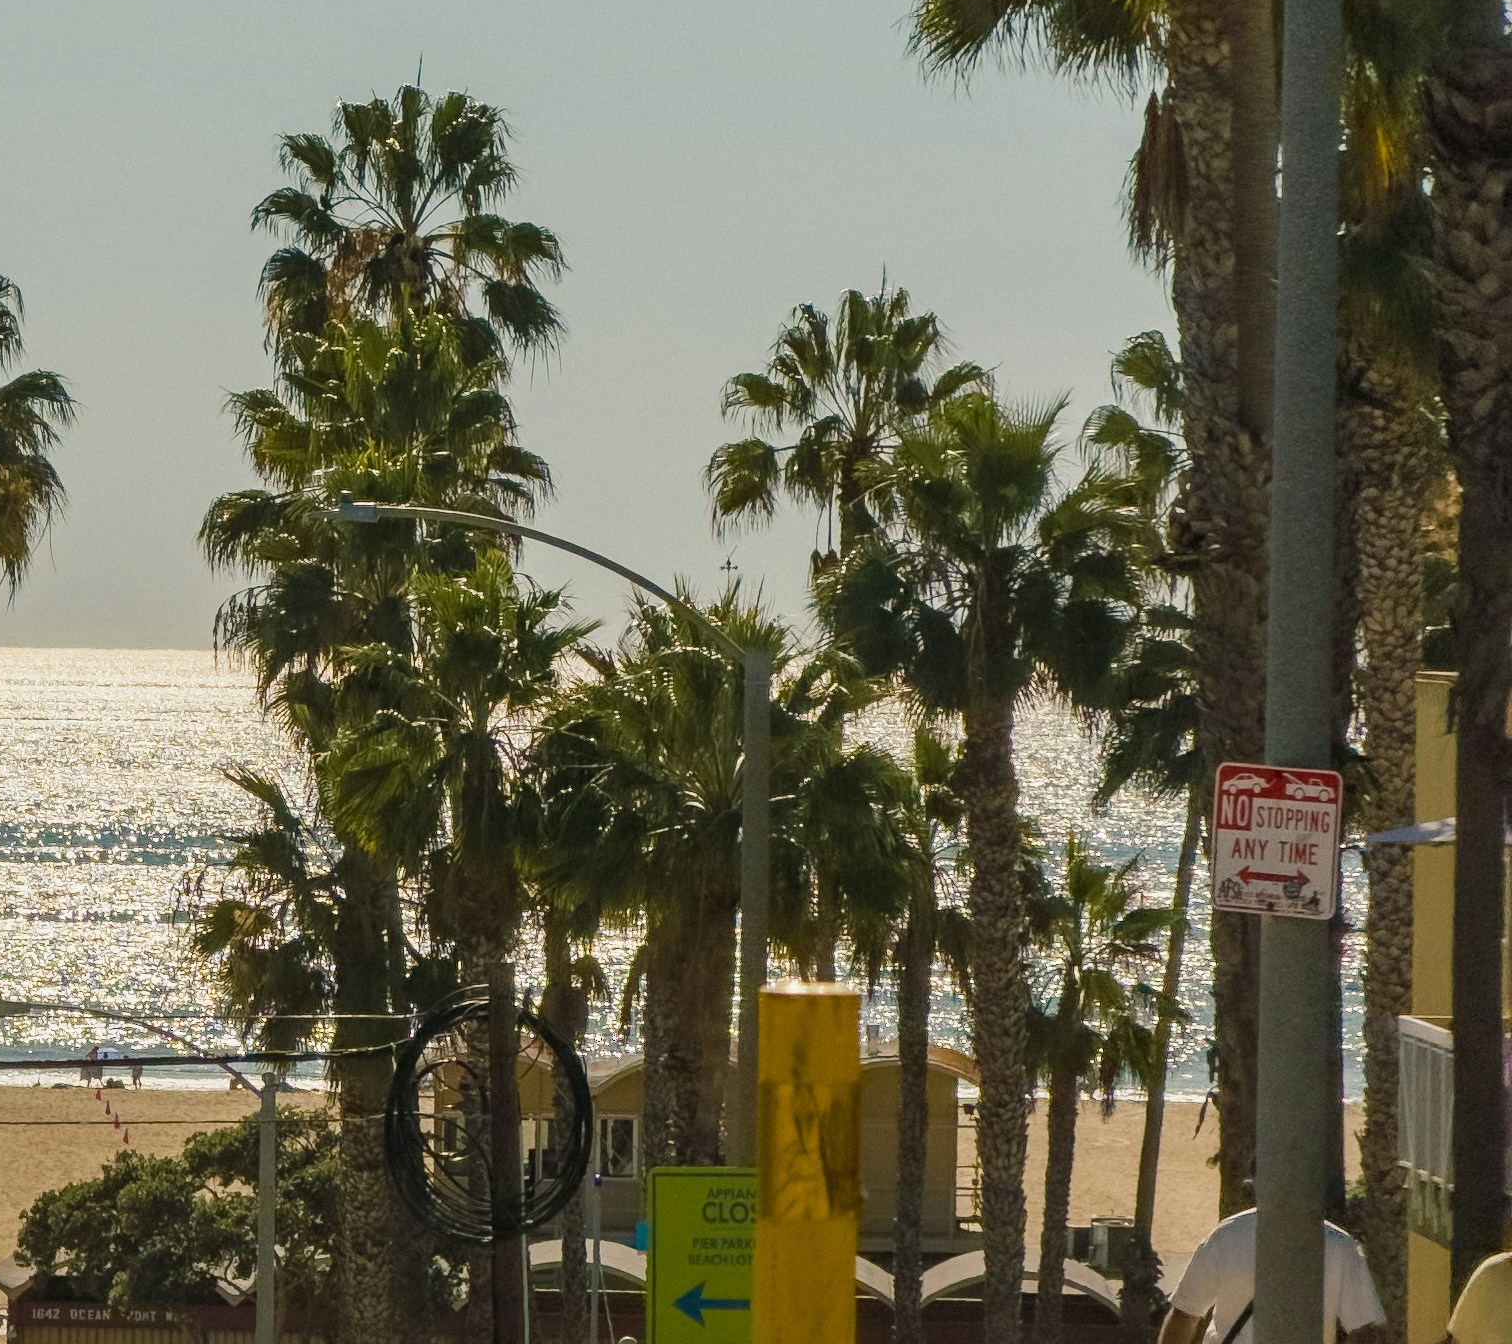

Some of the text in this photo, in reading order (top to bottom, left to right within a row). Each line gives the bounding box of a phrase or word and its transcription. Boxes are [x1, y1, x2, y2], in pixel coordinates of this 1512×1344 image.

[1221, 794, 1331, 834] NO STOPPING
[1231, 838, 1319, 866] ANY TIME
[692, 1238, 718, 1249] PIER
[688, 1255, 728, 1265] BEACH
[32, 1308, 60, 1320] 1642
[70, 1308, 112, 1321] OCEAN
